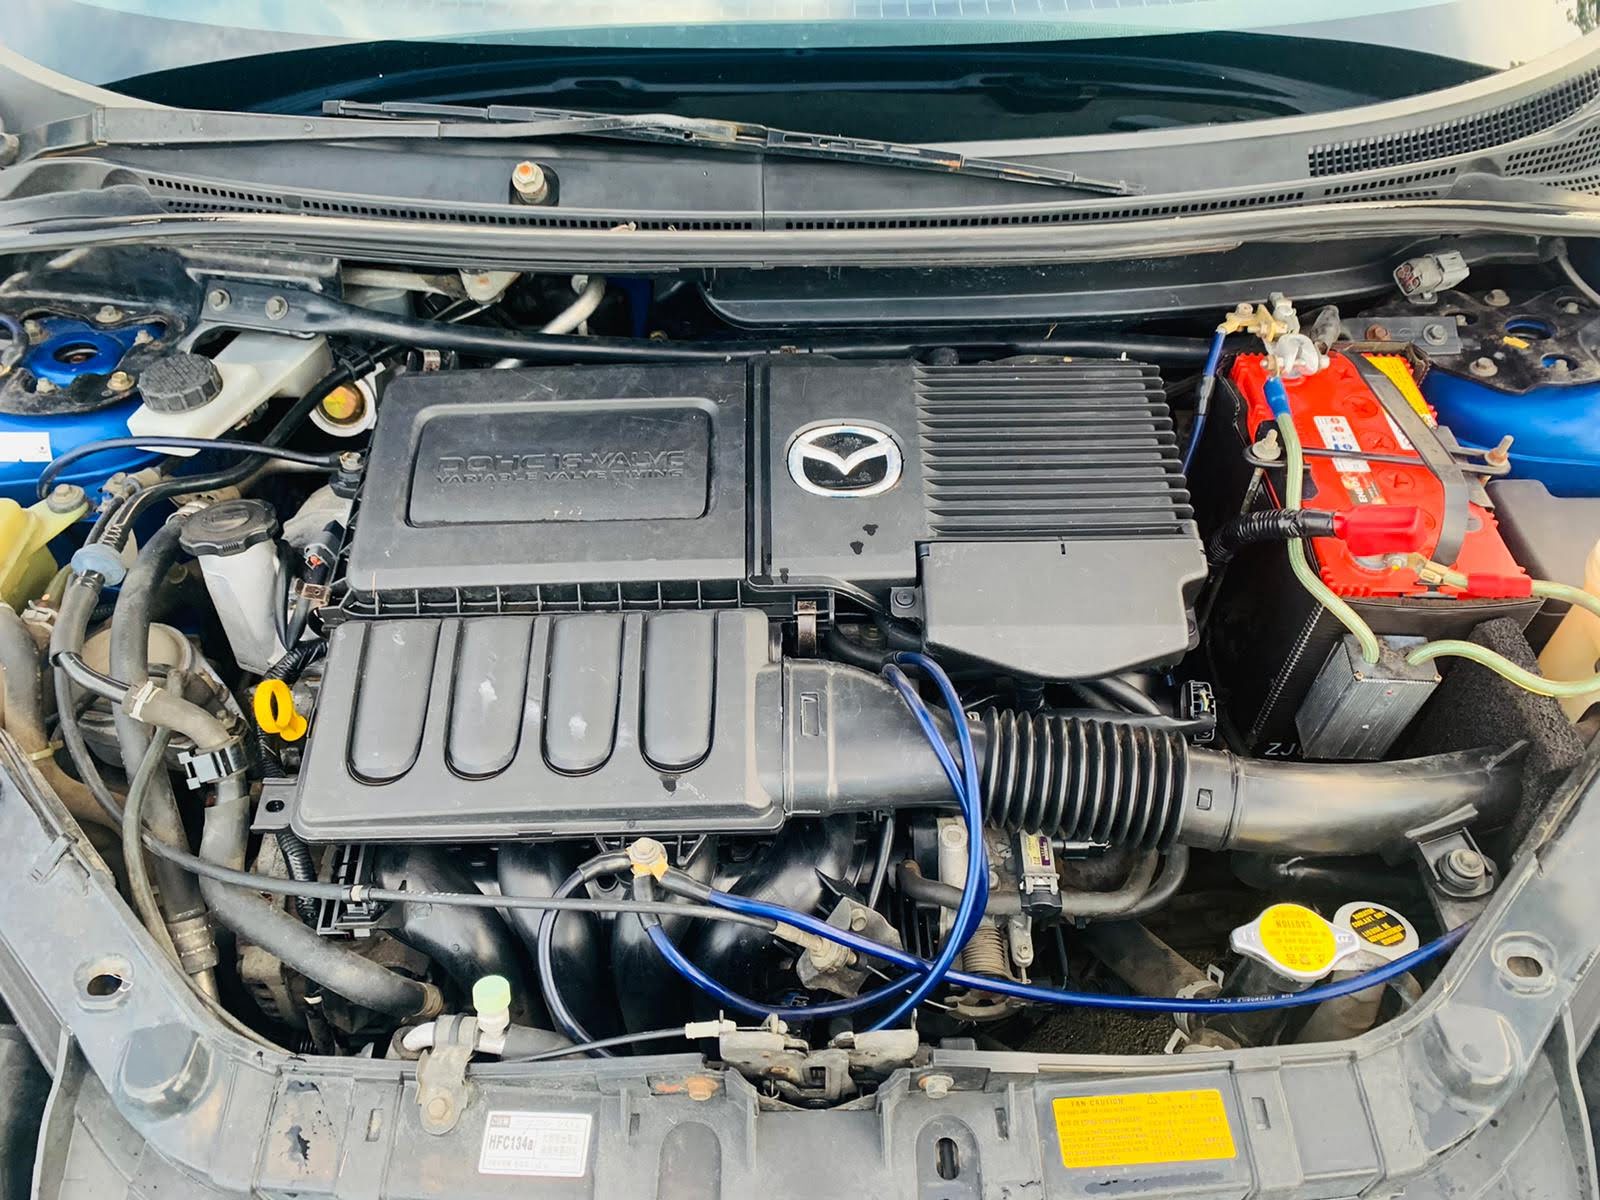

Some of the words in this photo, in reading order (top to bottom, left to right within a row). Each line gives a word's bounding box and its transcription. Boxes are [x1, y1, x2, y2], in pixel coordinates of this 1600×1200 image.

[439, 454, 546, 472] DOHC
[552, 451, 686, 469] 16-VALVE
[436, 471, 538, 484] VARIABLE
[544, 470, 607, 481] VALVE
[611, 468, 684, 480] TIMING
[488, 1134, 534, 1152] HFC134a
